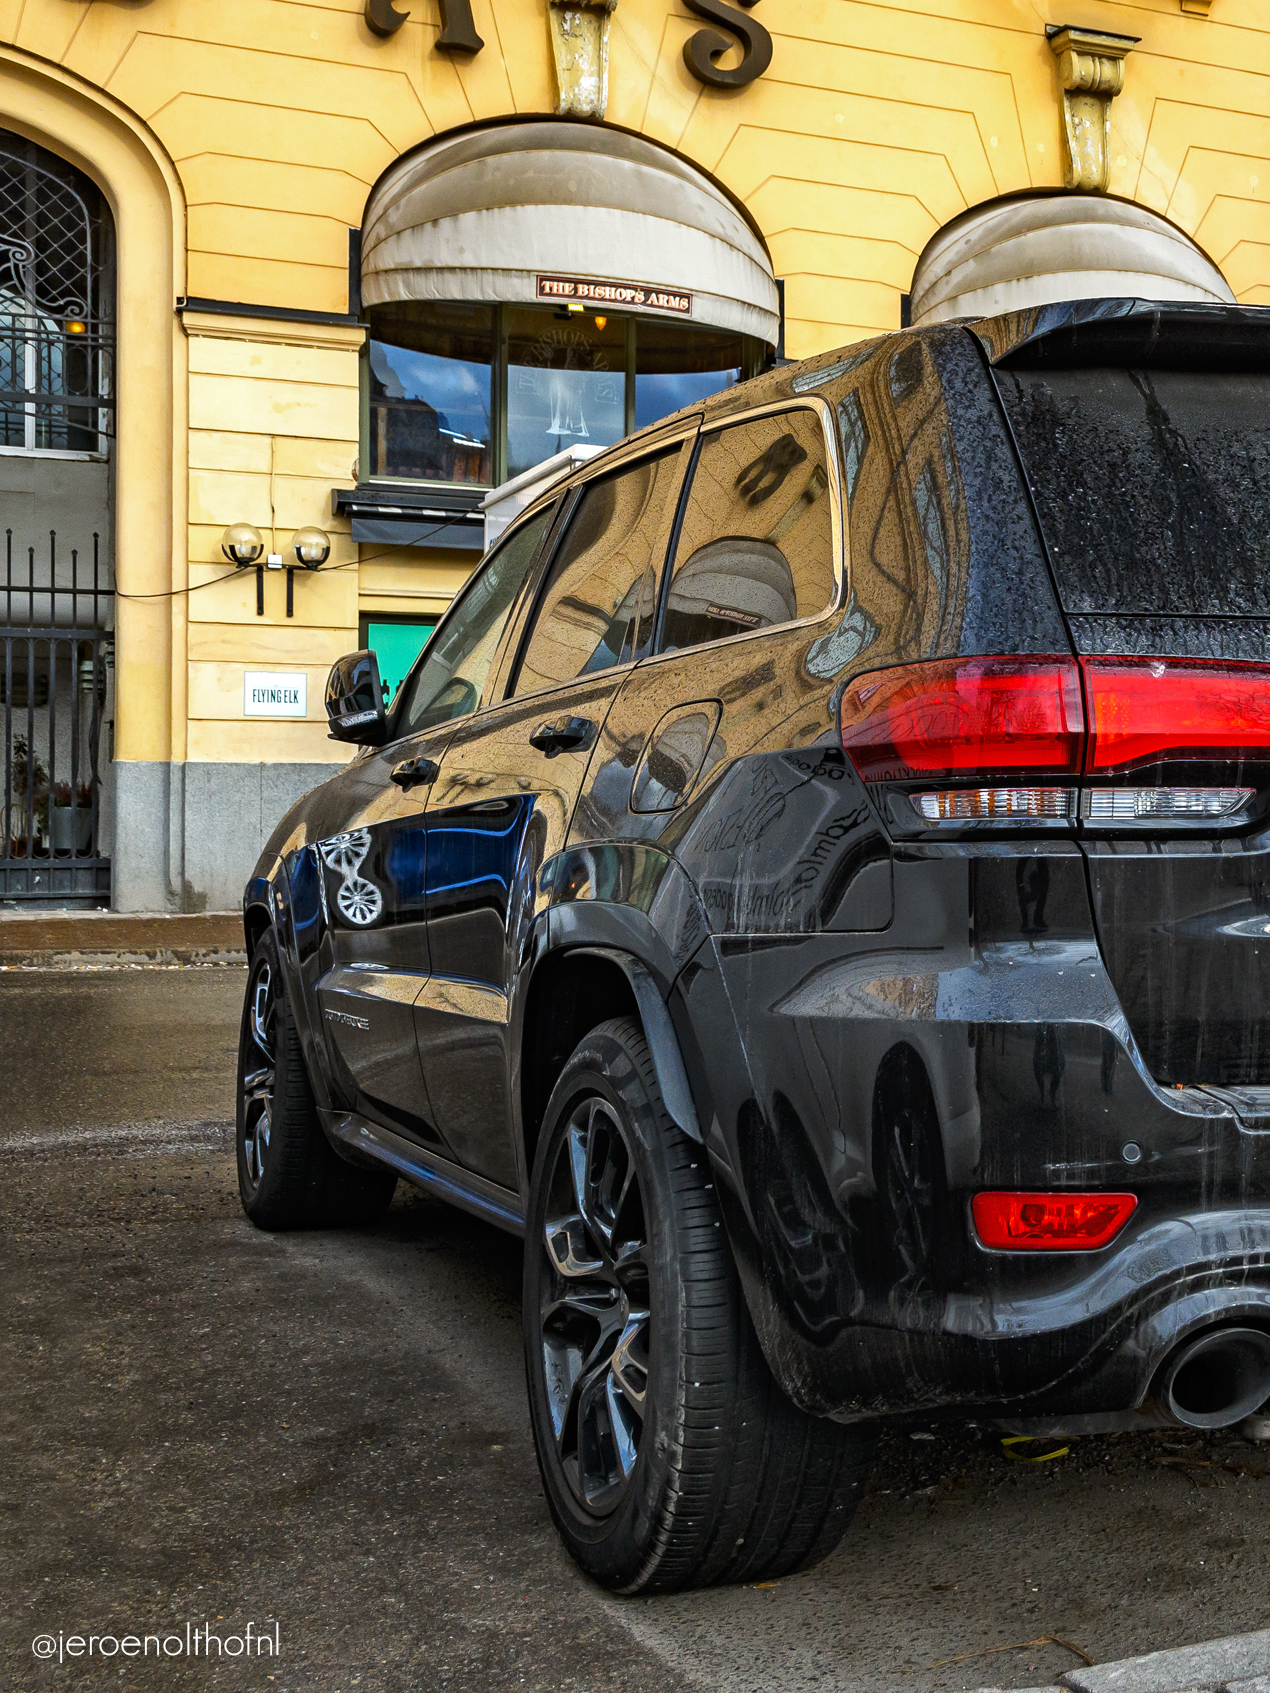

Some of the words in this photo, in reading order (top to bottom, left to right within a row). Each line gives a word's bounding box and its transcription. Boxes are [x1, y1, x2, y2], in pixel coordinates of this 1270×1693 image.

[541, 281, 575, 295] THE
[646, 292, 689, 310] ARMS
[252, 689, 282, 703] FLYING
[284, 690, 299, 704] ELK
